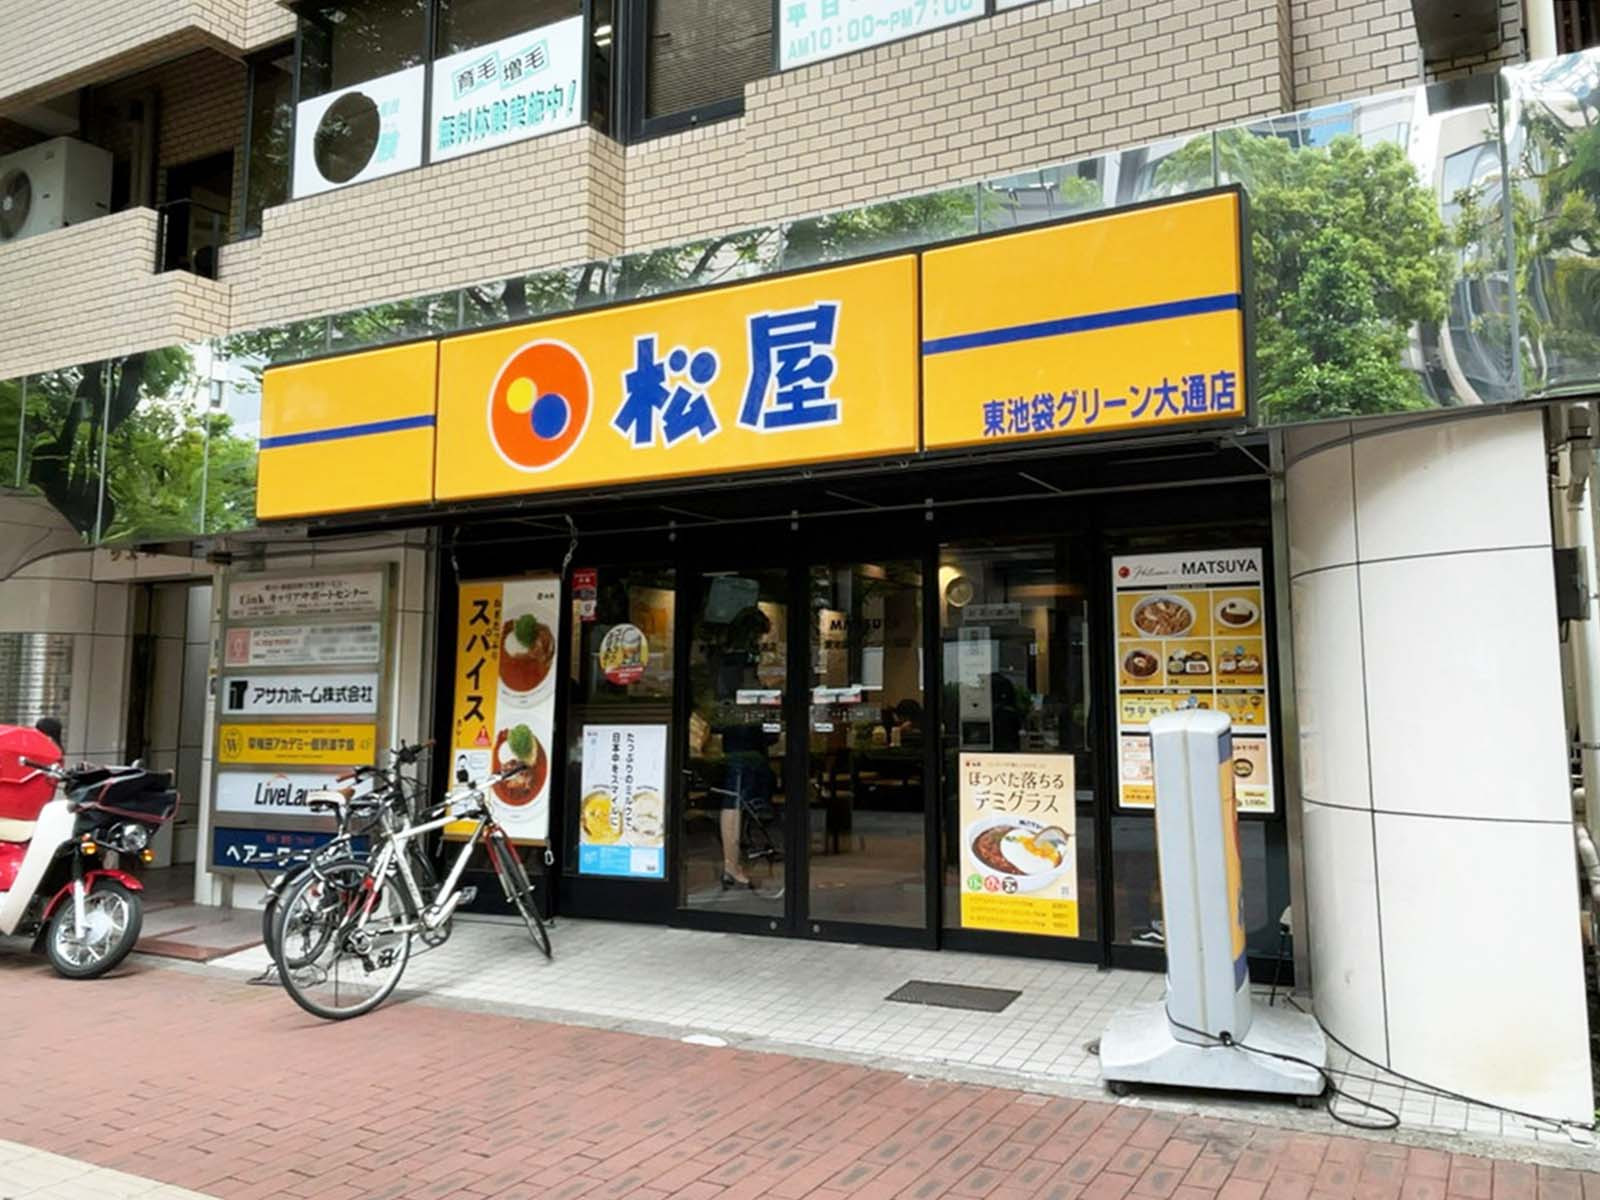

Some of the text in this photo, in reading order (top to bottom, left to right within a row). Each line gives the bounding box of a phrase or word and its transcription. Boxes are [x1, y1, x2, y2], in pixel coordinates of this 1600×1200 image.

[457, 46, 546, 91] 育毛 増毛
[610, 300, 842, 450] 松屋
[983, 371, 1236, 439] 東池袋グリーン大通店
[1181, 559, 1258, 575] MATSUYA
[463, 599, 491, 721] スパイス
[253, 686, 372, 704] アサカホーム株式会社
[975, 791, 1059, 814] デミグラス
